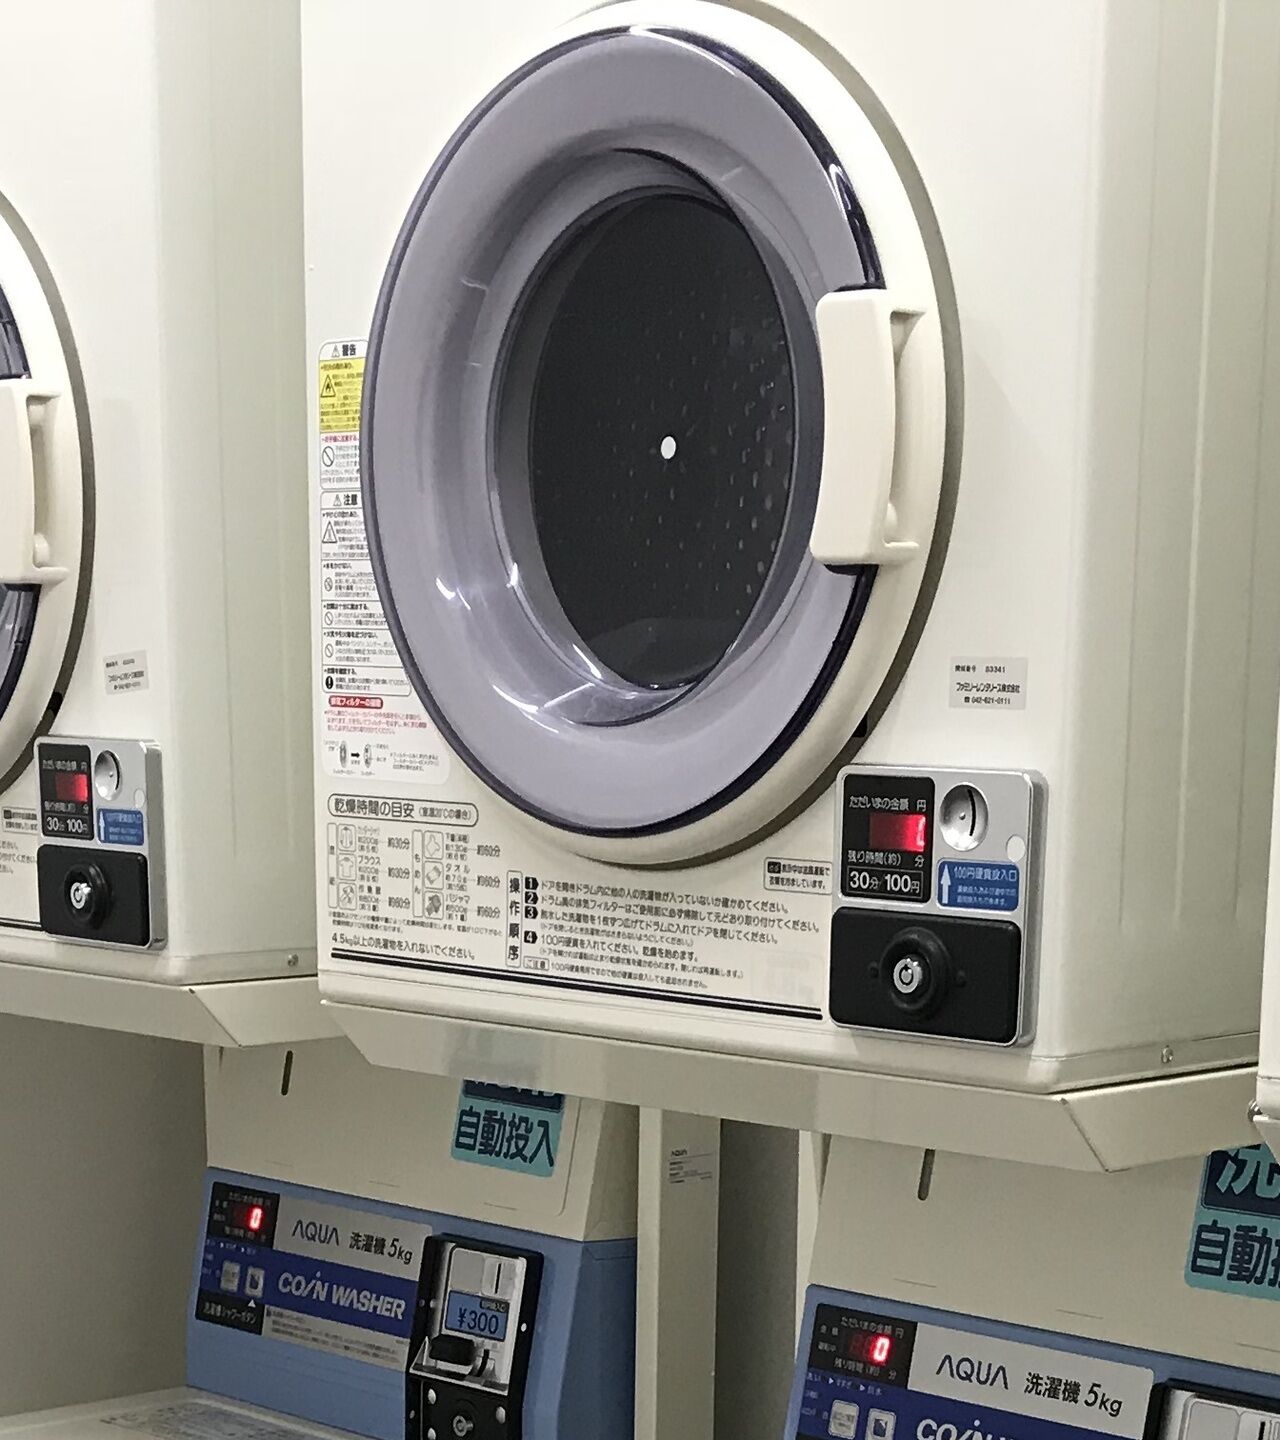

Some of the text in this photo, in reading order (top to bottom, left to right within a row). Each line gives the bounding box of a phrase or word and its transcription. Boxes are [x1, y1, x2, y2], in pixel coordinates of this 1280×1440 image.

[334, 798, 415, 819] 乾燥時間の目安
[849, 795, 927, 813] ただいまの金額 円
[914, 855, 925, 869] 分
[507, 876, 521, 961] 操作順序
[454, 1104, 555, 1168] 自動投入
[249, 1207, 263, 1230] 0
[291, 1218, 340, 1246] AQUA
[349, 1231, 386, 1257] 洗濯機
[387, 1237, 413, 1266] 5kg
[331, 1283, 407, 1320] WASHER
[457, 1306, 499, 1335] ¥300
[873, 1336, 891, 1363] 0
[935, 1353, 1123, 1418] AQUA 洗濯機 5kg
